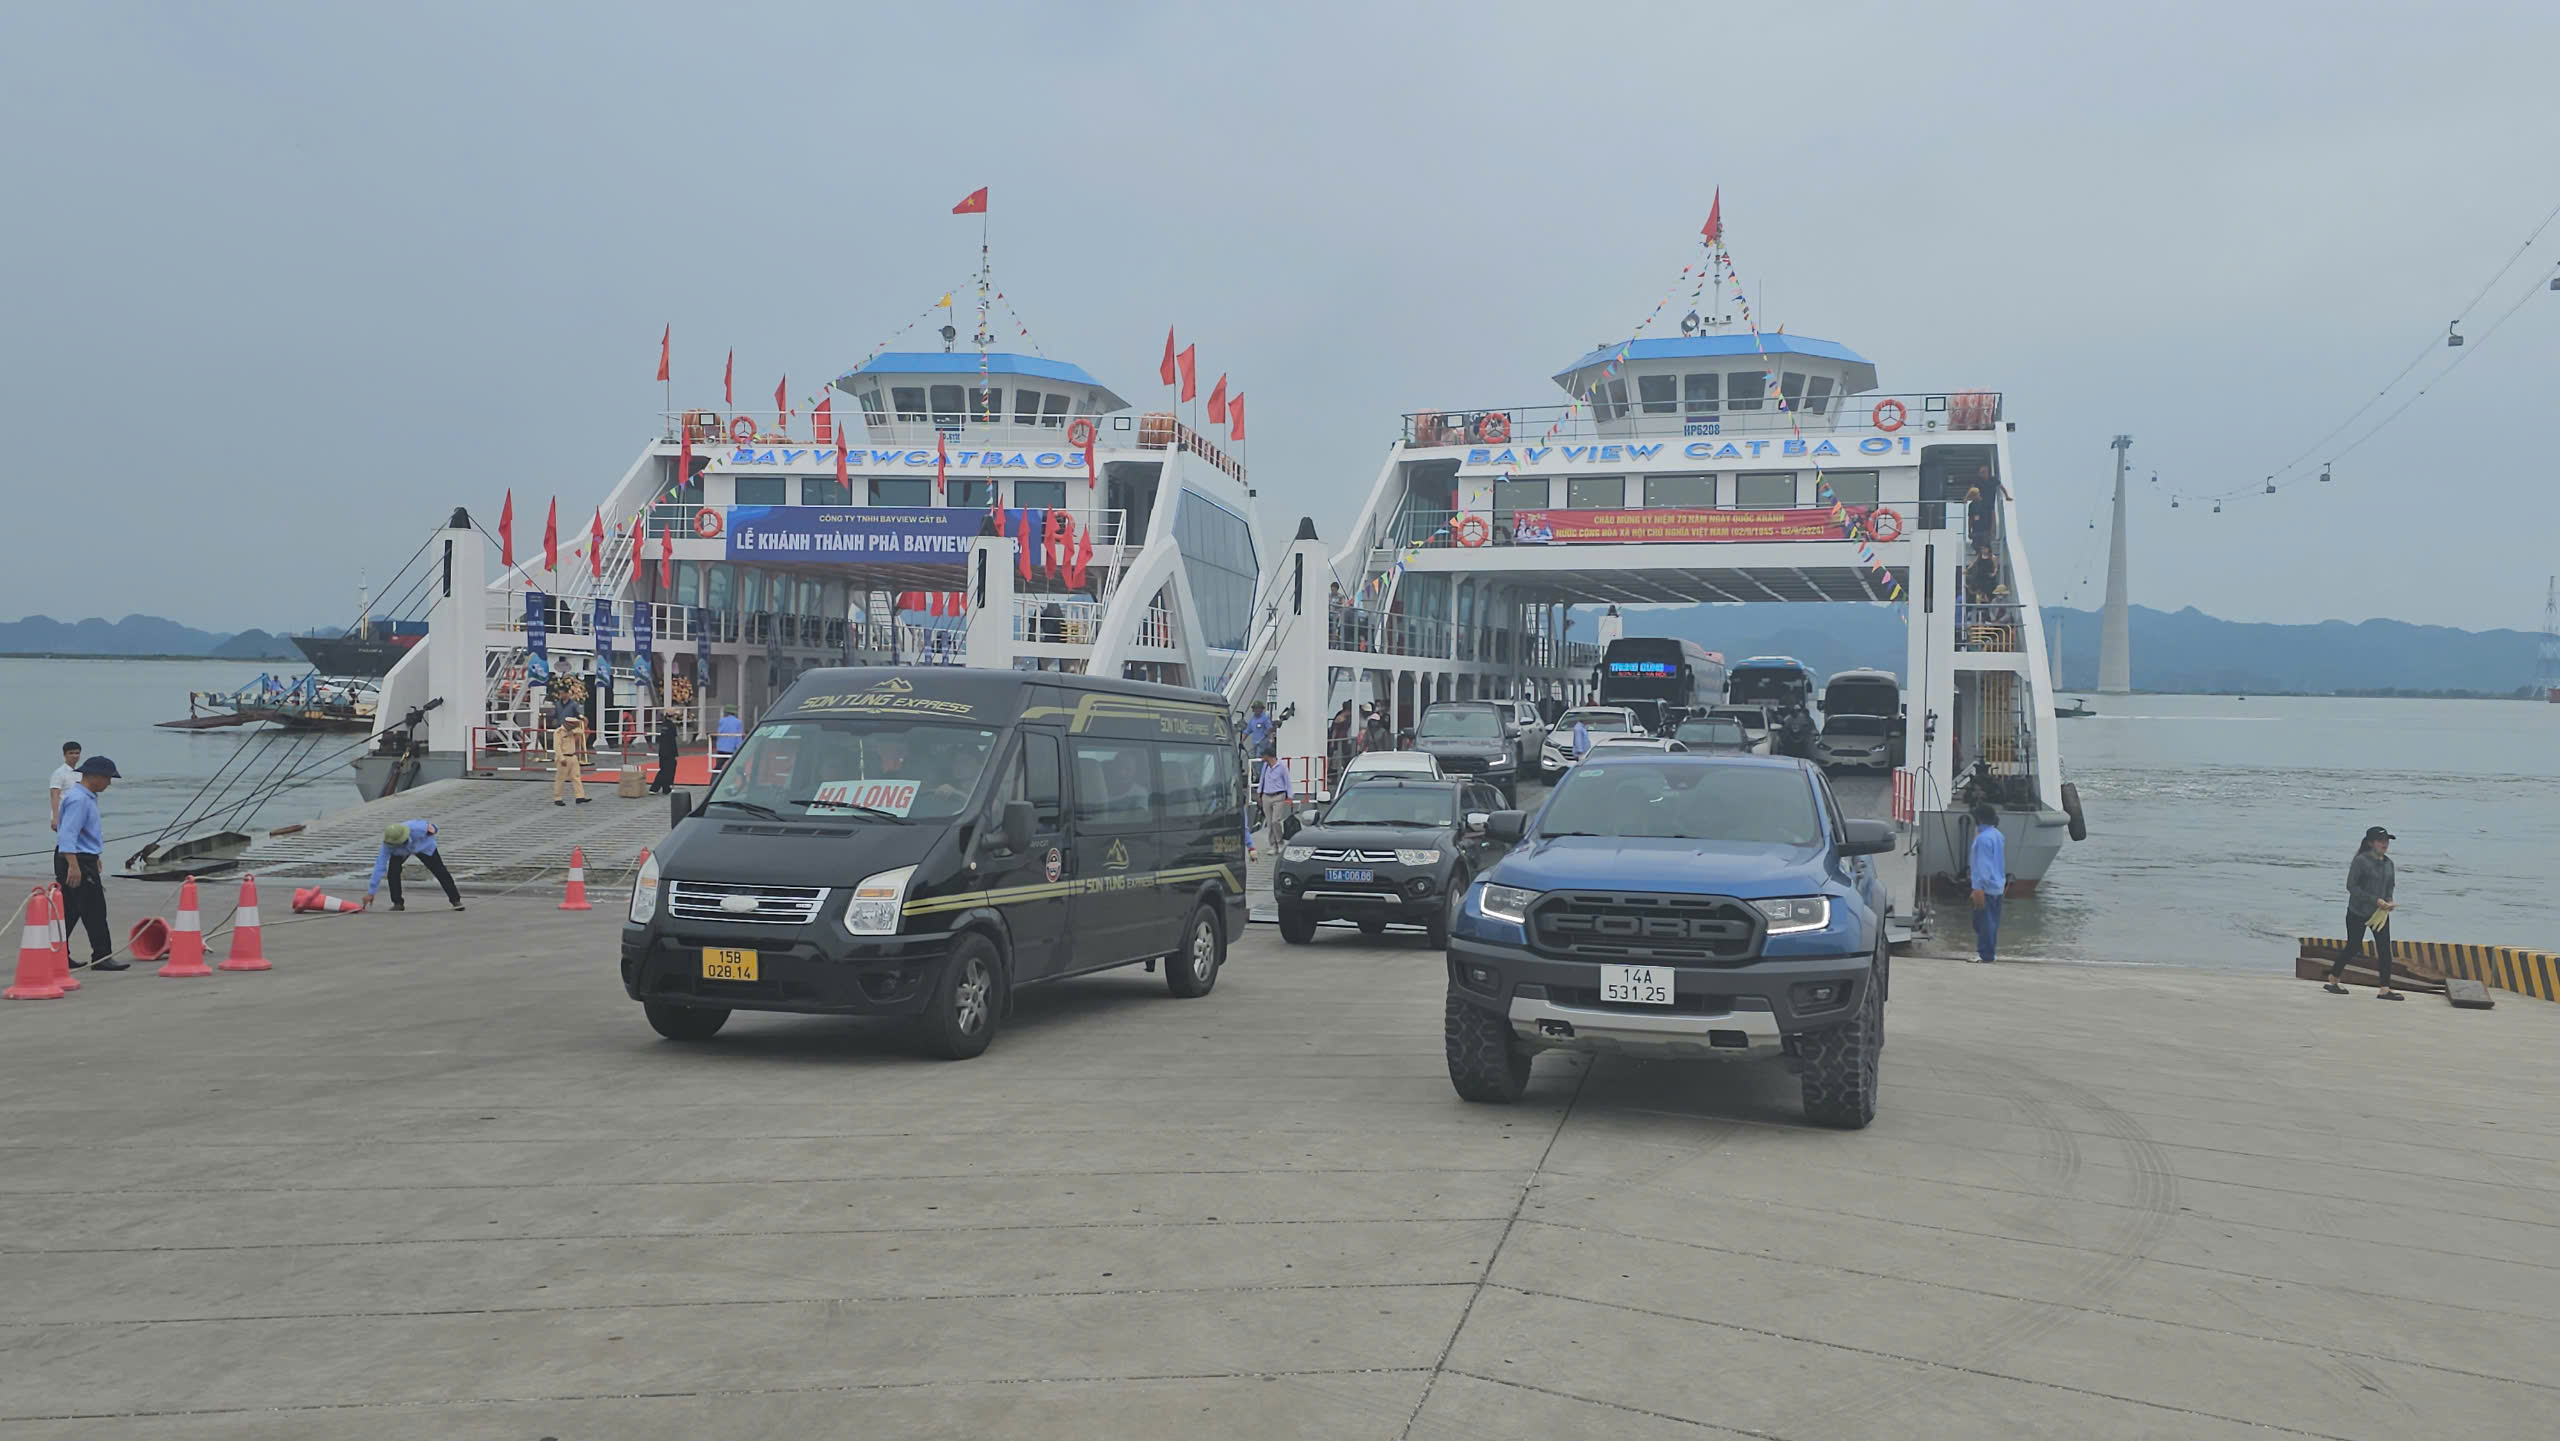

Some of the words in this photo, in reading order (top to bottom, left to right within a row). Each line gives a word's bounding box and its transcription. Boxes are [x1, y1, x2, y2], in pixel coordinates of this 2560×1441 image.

[1683, 425, 1720, 437] HP6208
[1684, 440, 1770, 460] CAT
[1782, 439, 1841, 458] BA
[819, 514, 842, 523] CÔNG
[845, 515, 856, 523] TY
[857, 515, 879, 523] TNHH
[880, 515, 917, 524] BAYVIEW
[736, 527, 754, 550] LỄ
[758, 530, 811, 551] KHÁNH
[814, 530, 865, 552] THÀNH
[868, 531, 900, 552] PHÀ
[896, 697, 974, 714] EXPRESS
[851, 783, 915, 809] LONG
[1541, 912, 1749, 939] FORD
[719, 950, 741, 964] 15B
[708, 964, 751, 979] 028.14
[1623, 968, 1652, 984] 14A
[1608, 984, 1666, 1002] 531.25
